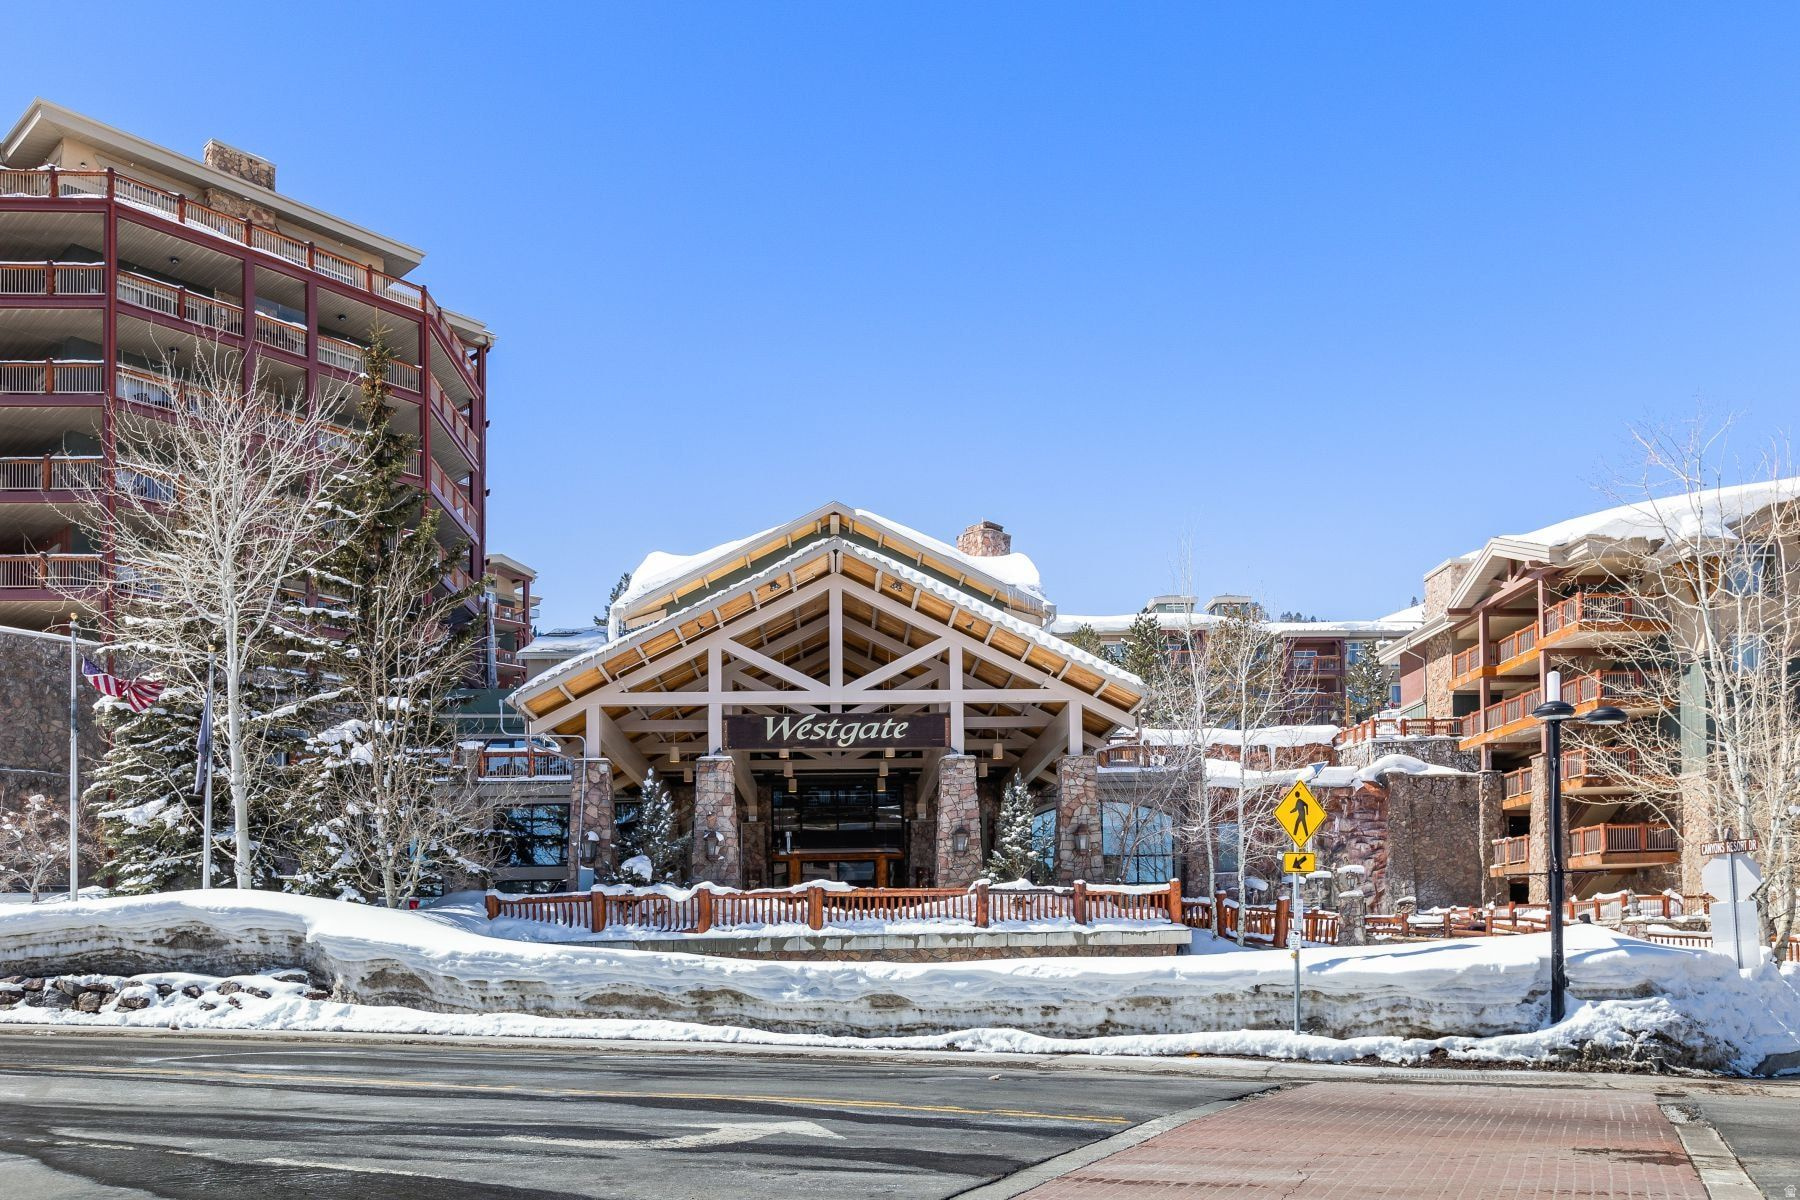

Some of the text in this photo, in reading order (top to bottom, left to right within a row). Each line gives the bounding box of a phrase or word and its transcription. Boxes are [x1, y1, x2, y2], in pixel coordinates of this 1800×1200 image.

[764, 714, 909, 747] Westgate
[1701, 839, 1757, 855] CANYONS RESORT DR
